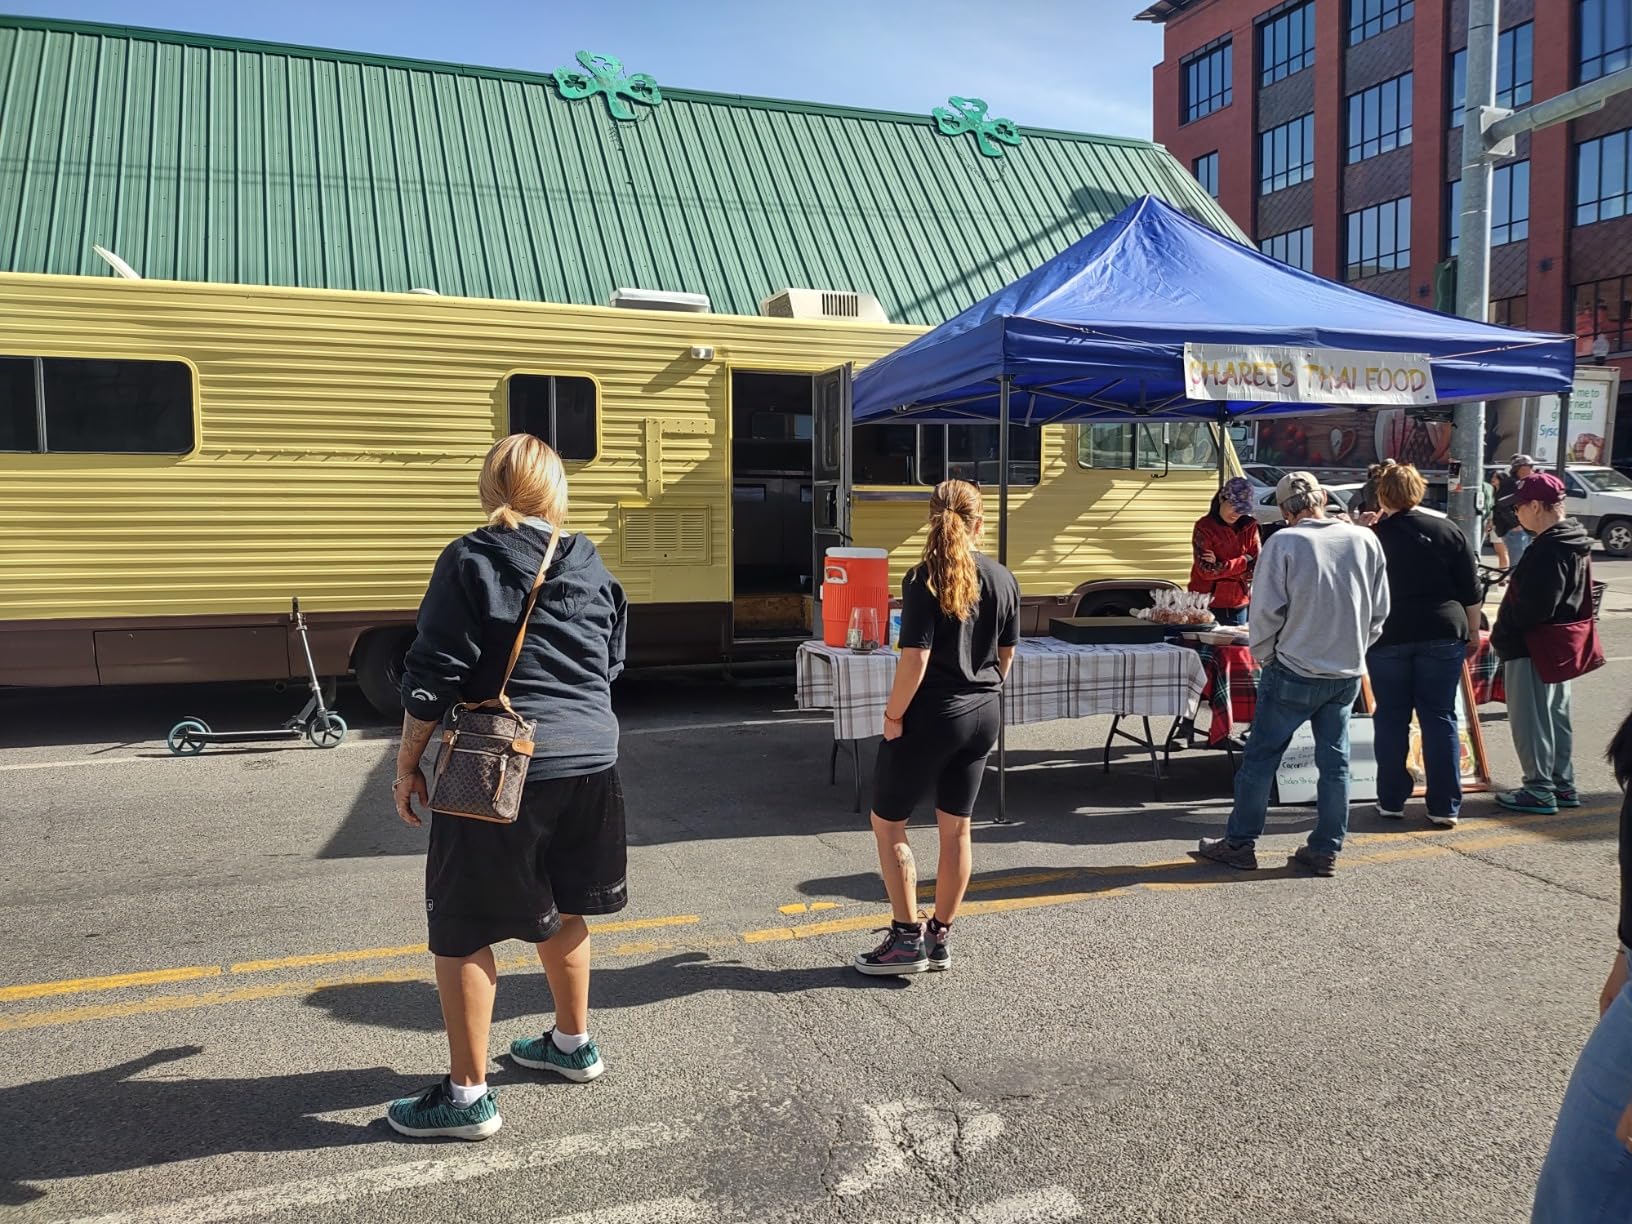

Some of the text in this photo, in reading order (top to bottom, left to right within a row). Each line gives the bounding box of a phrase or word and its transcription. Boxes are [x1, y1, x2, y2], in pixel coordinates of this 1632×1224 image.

[1190, 361, 1427, 393] CHAREE'S THAI FOOD
[1591, 389, 1600, 399] to
[1574, 401, 1592, 409] next
[1574, 410, 1593, 420] meal
